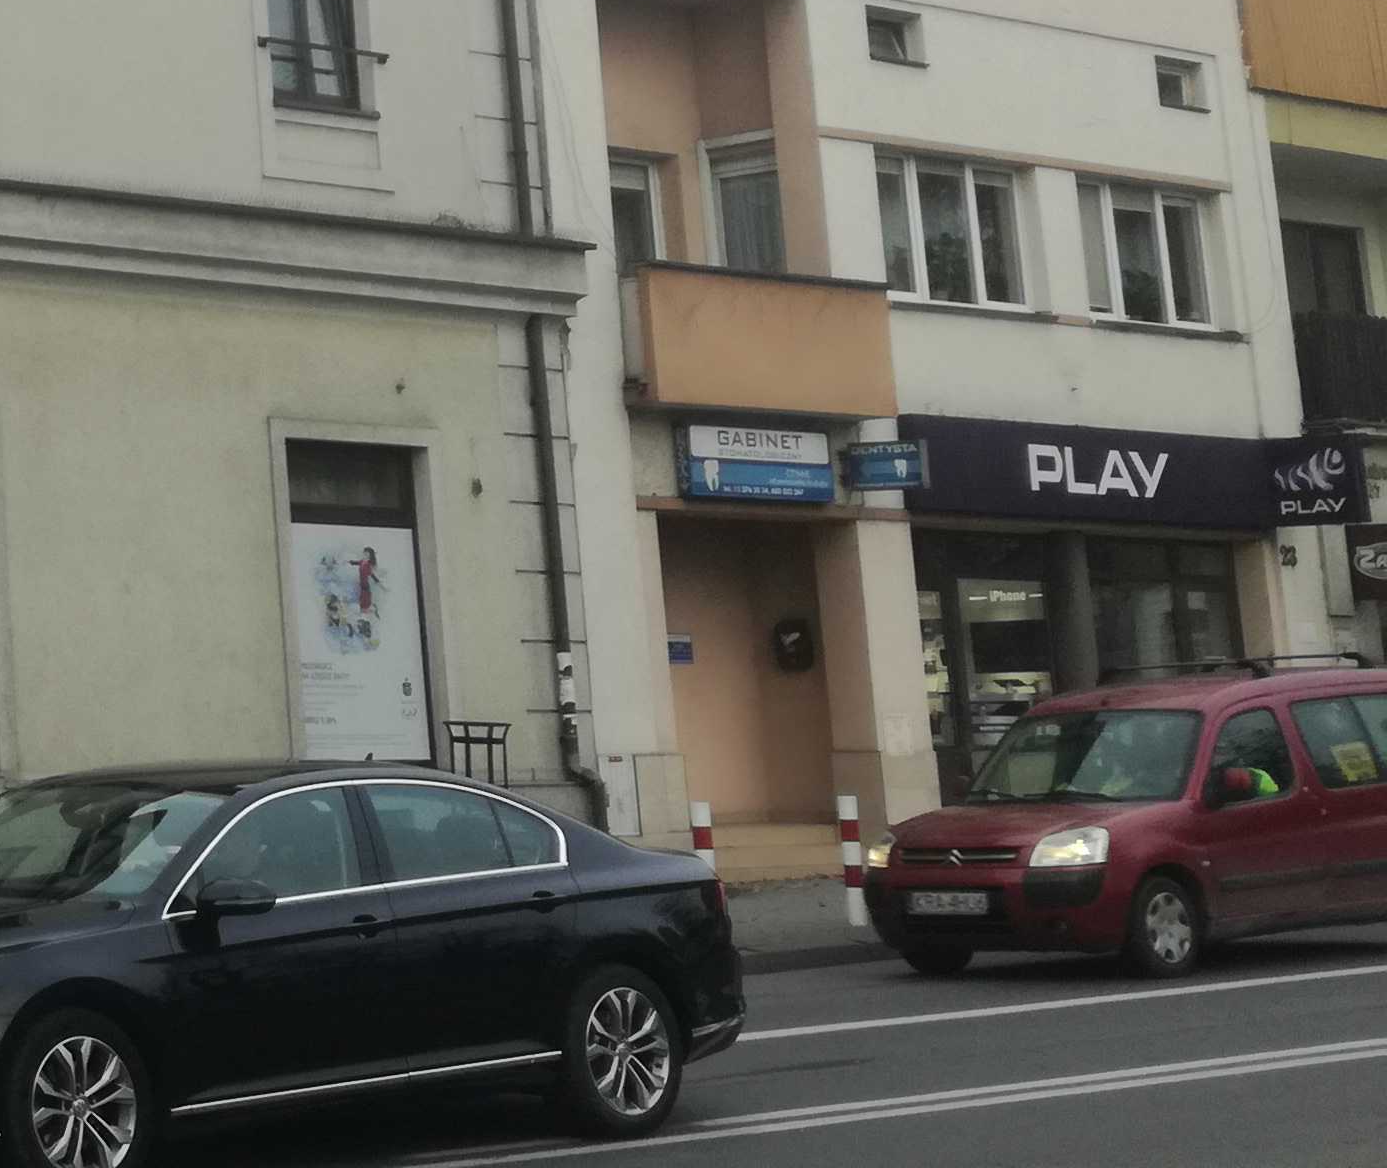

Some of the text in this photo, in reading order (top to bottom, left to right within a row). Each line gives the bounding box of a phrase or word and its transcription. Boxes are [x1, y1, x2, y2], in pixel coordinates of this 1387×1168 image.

[717, 430, 803, 449] GABINET
[851, 443, 918, 455] DENTYSTA
[1028, 444, 1169, 498] PLAY
[1280, 497, 1347, 515] PLAY
[989, 590, 1027, 602] iPhone
